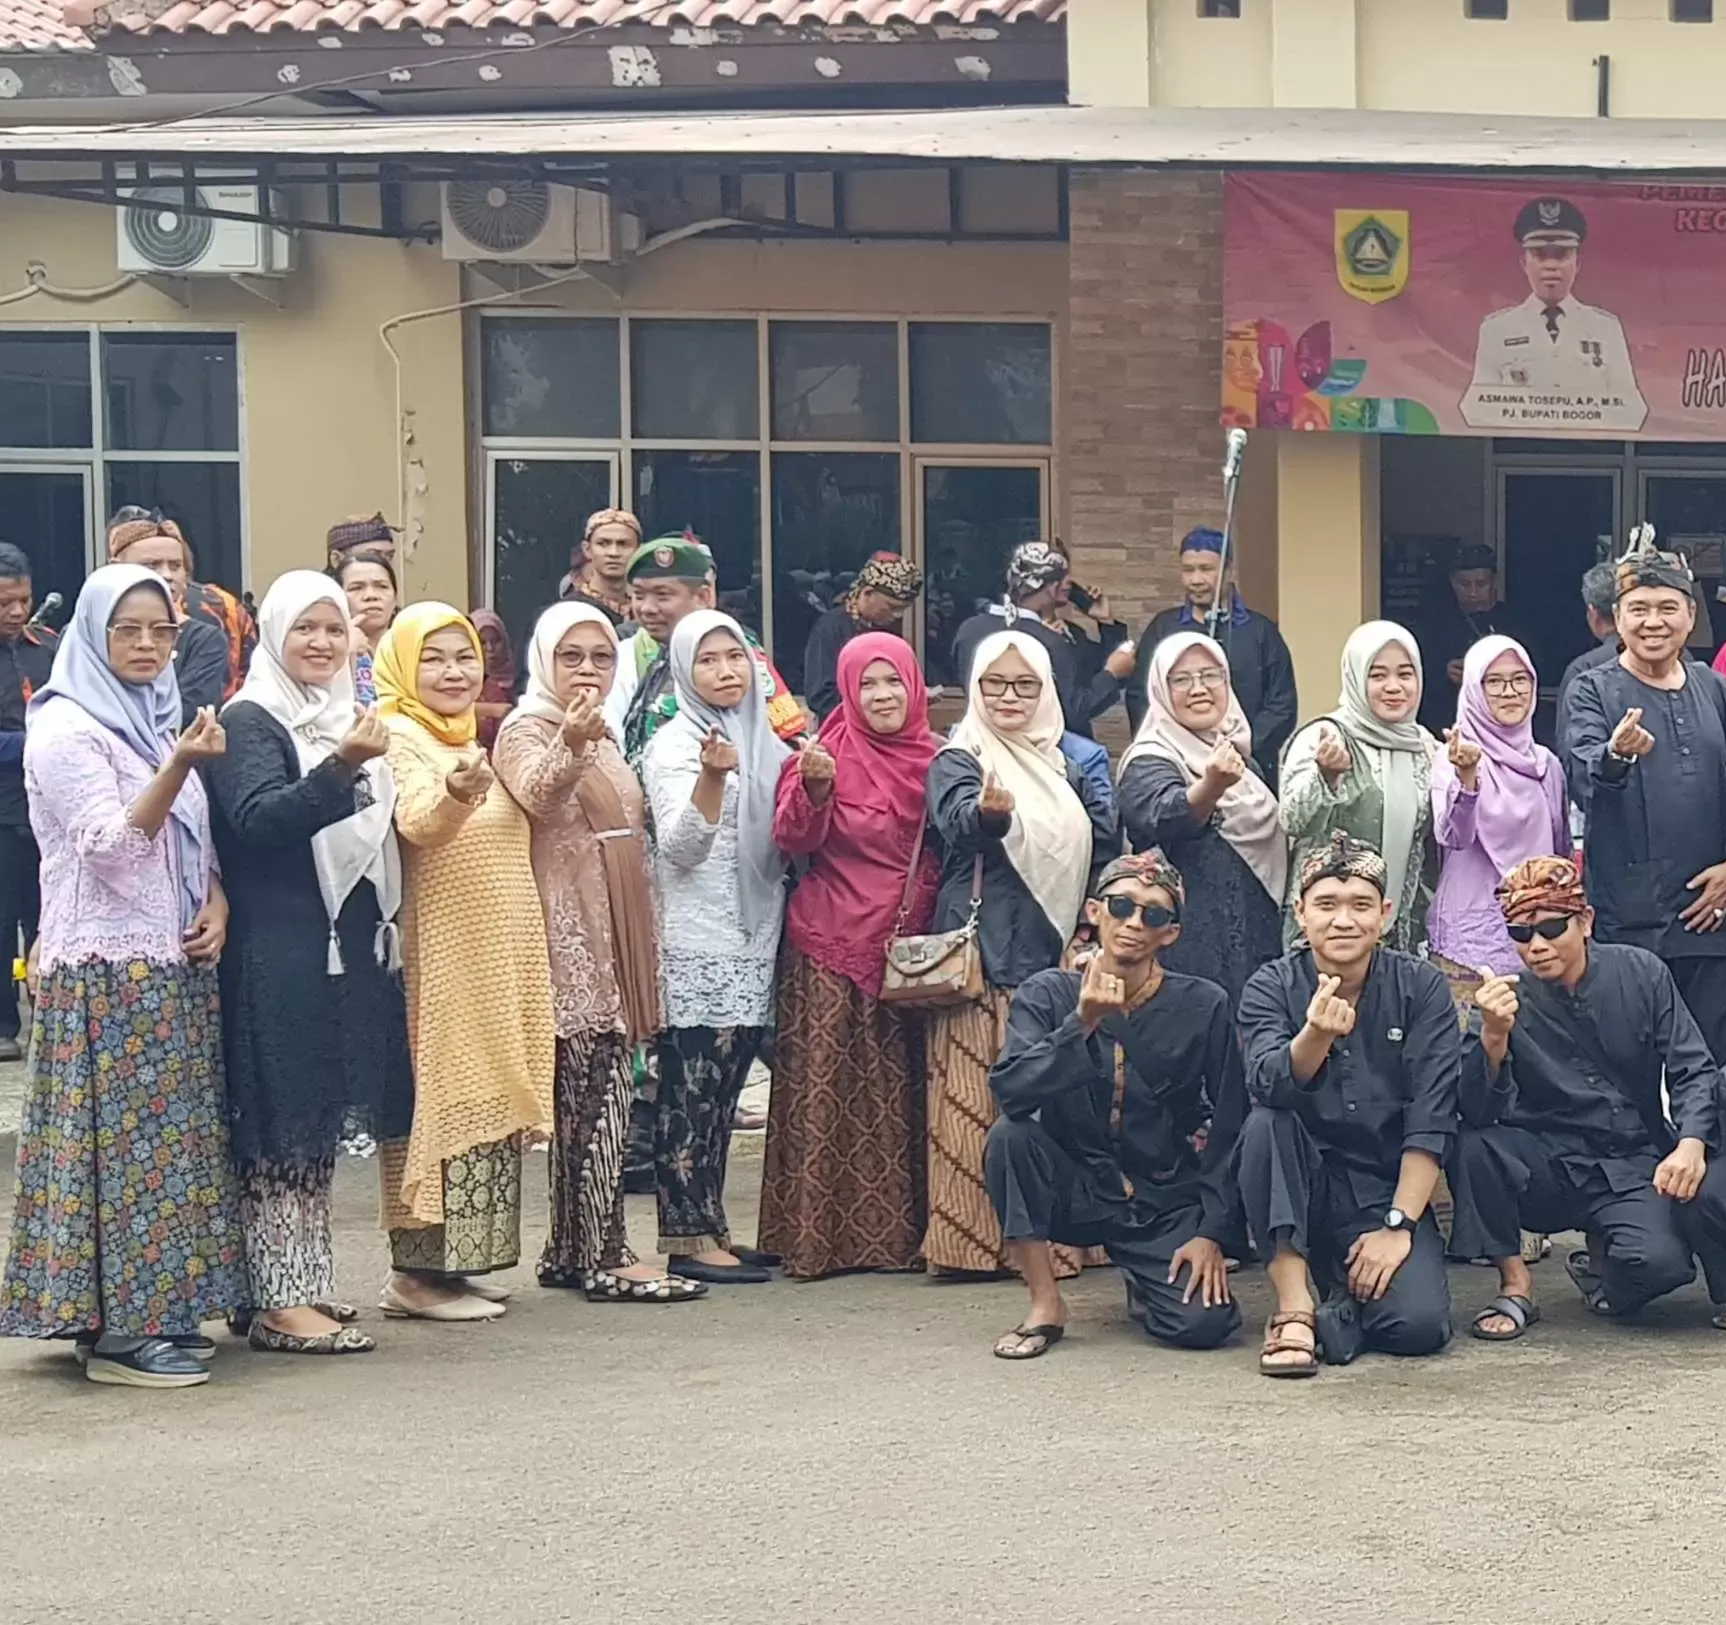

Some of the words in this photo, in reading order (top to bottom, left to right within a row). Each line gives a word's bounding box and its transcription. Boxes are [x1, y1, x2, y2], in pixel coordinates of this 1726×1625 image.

[1478, 394, 1526, 405] ASMAWA
[1521, 410, 1560, 420] BUPATI
[1562, 411, 1602, 421] BOGOR
